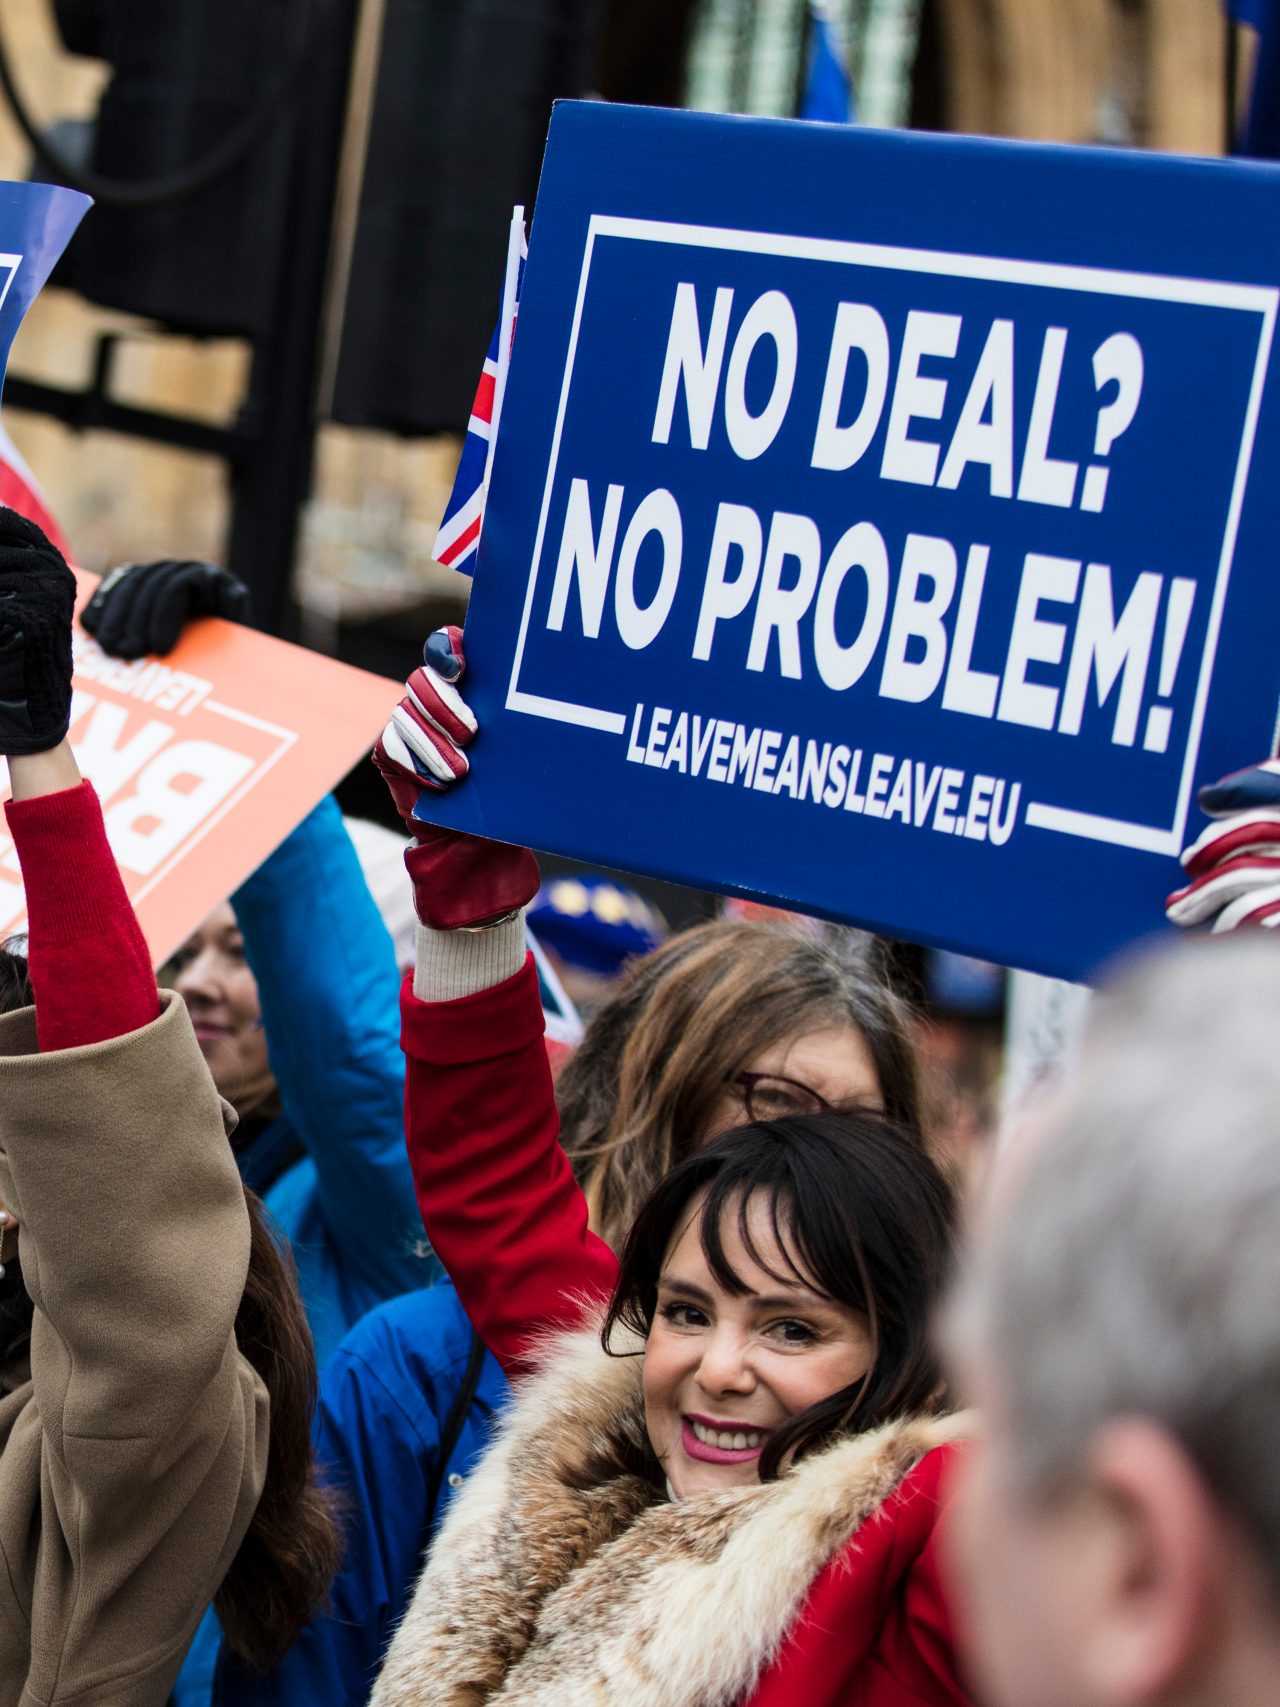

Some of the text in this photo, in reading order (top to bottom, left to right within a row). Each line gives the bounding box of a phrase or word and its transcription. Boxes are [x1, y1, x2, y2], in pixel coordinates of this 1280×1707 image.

[651, 281, 1145, 514] NO DEAL?
[546, 477, 1198, 754] NO PROBLEM!
[626, 703, 1023, 846] LEAVEMEANSLEAVE.EU
